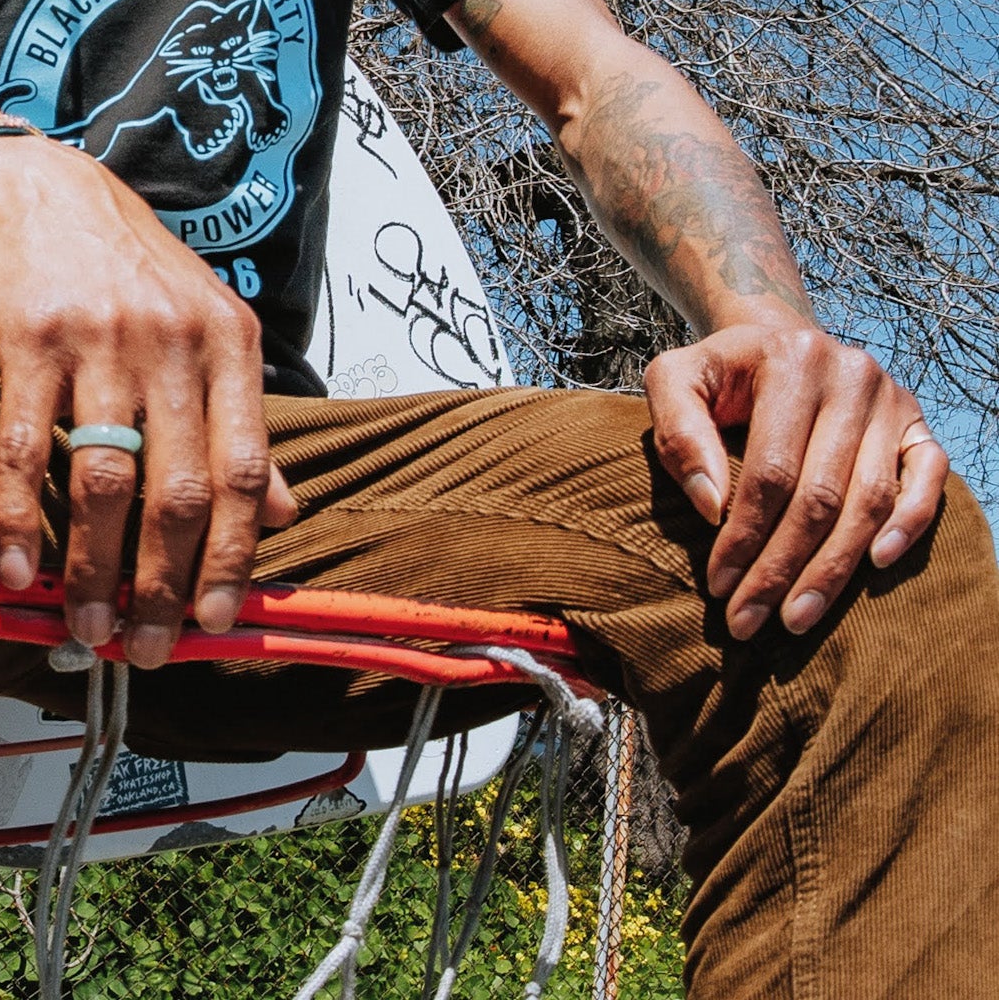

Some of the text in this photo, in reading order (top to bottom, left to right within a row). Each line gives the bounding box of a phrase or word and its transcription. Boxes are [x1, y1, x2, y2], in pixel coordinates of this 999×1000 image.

[180, 170, 279, 244] POWER
[118, 770, 171, 791] SKATESHOP
[162, 782, 176, 792] CA
